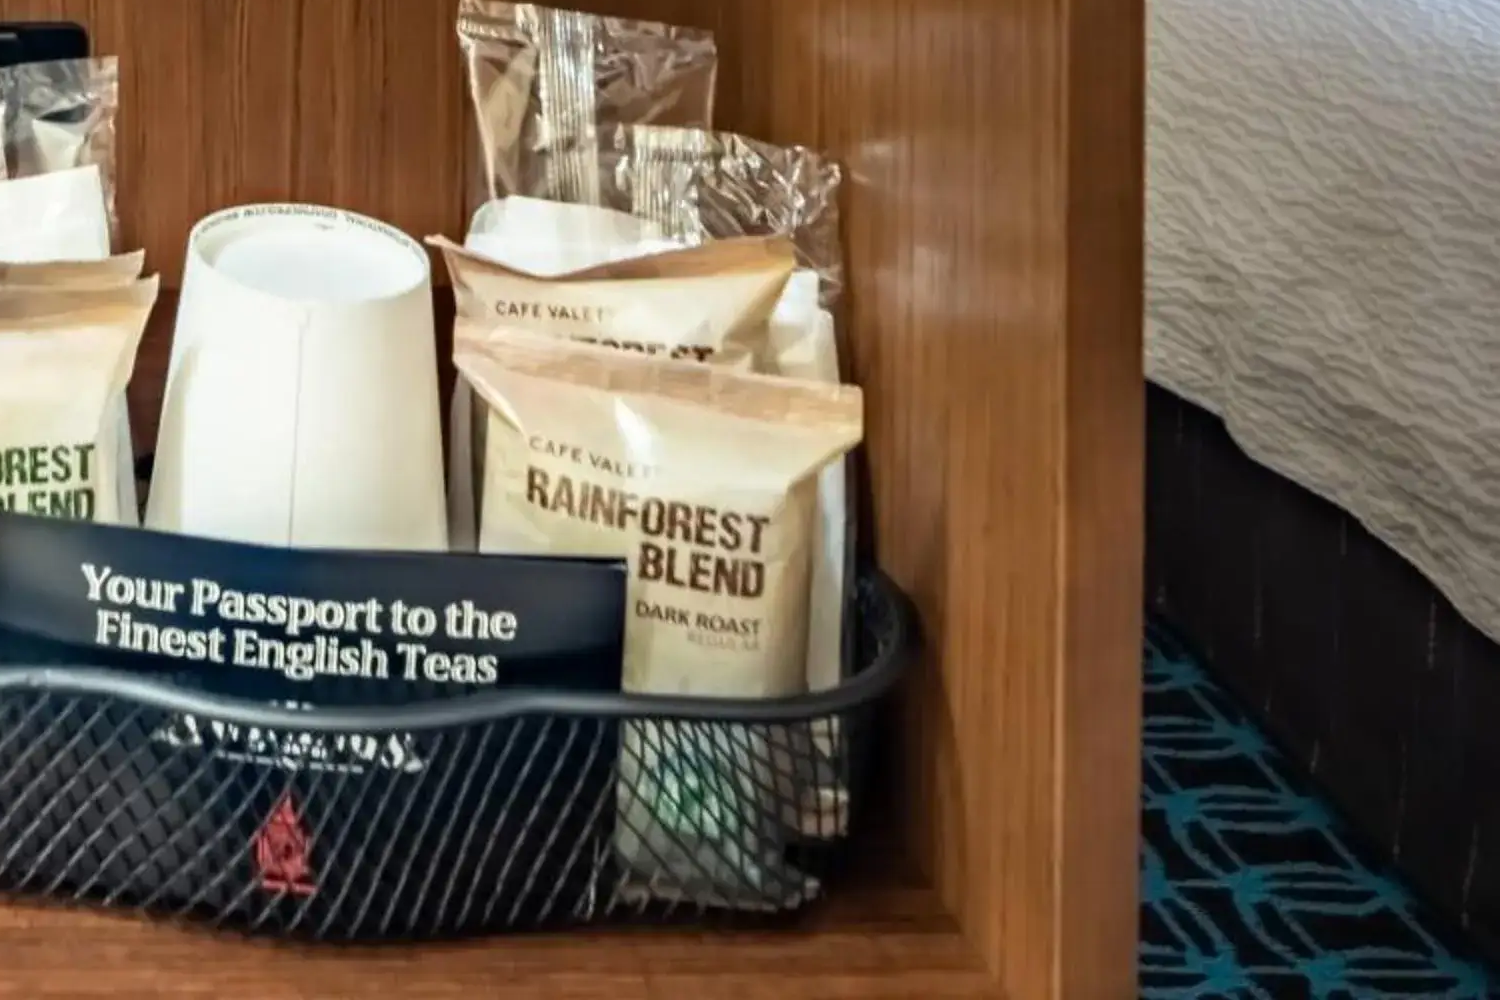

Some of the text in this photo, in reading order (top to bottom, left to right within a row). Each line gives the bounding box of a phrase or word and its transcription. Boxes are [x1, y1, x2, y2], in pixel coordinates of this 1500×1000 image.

[529, 435, 583, 465] CAFE
[526, 465, 771, 554] RAINFOREST
[80, 562, 518, 641] Your Passport to the
[637, 541, 766, 598] BLEND
[95, 608, 498, 684] Finest English Teas
[635, 599, 761, 636] DARK ROAST
